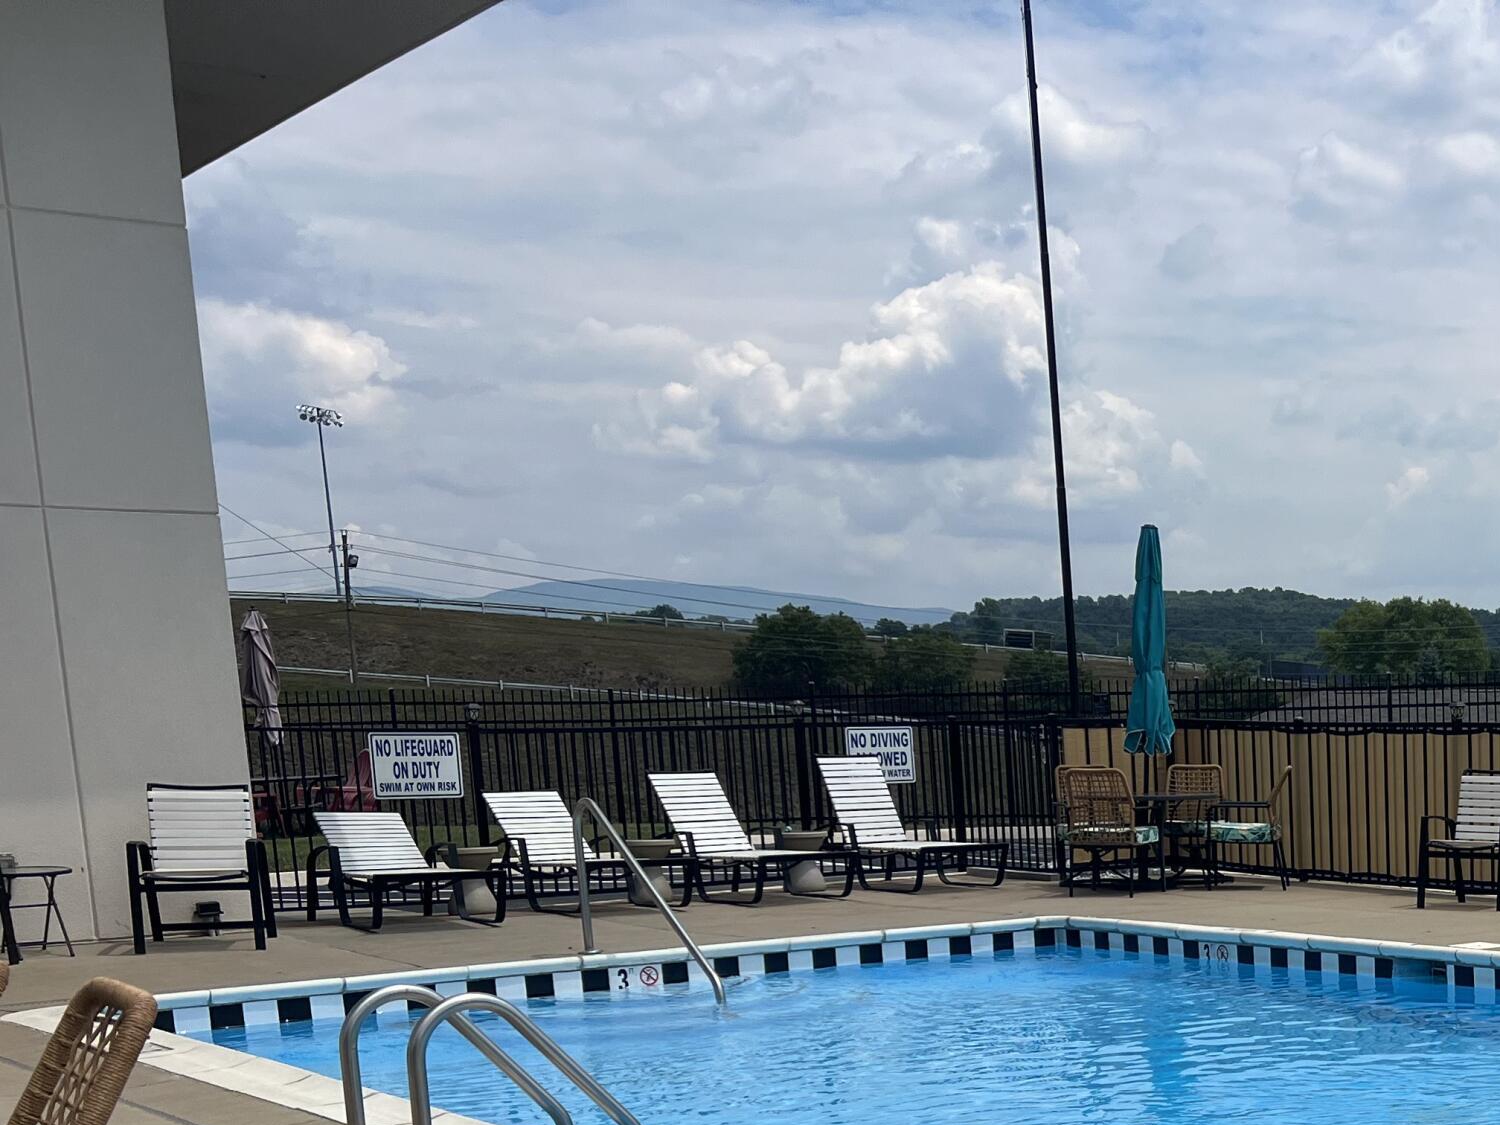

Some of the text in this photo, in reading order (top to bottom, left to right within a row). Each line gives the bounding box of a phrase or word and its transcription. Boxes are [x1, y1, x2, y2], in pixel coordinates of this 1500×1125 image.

[375, 739, 454, 757] NO LIFEGUARD
[850, 732, 909, 748] NO DIVING
[393, 761, 440, 779] ON DUTY
[887, 768, 911, 777] WATER
[379, 781, 457, 793] SWIM AT OWN RISK
[617, 968, 629, 990] 3
